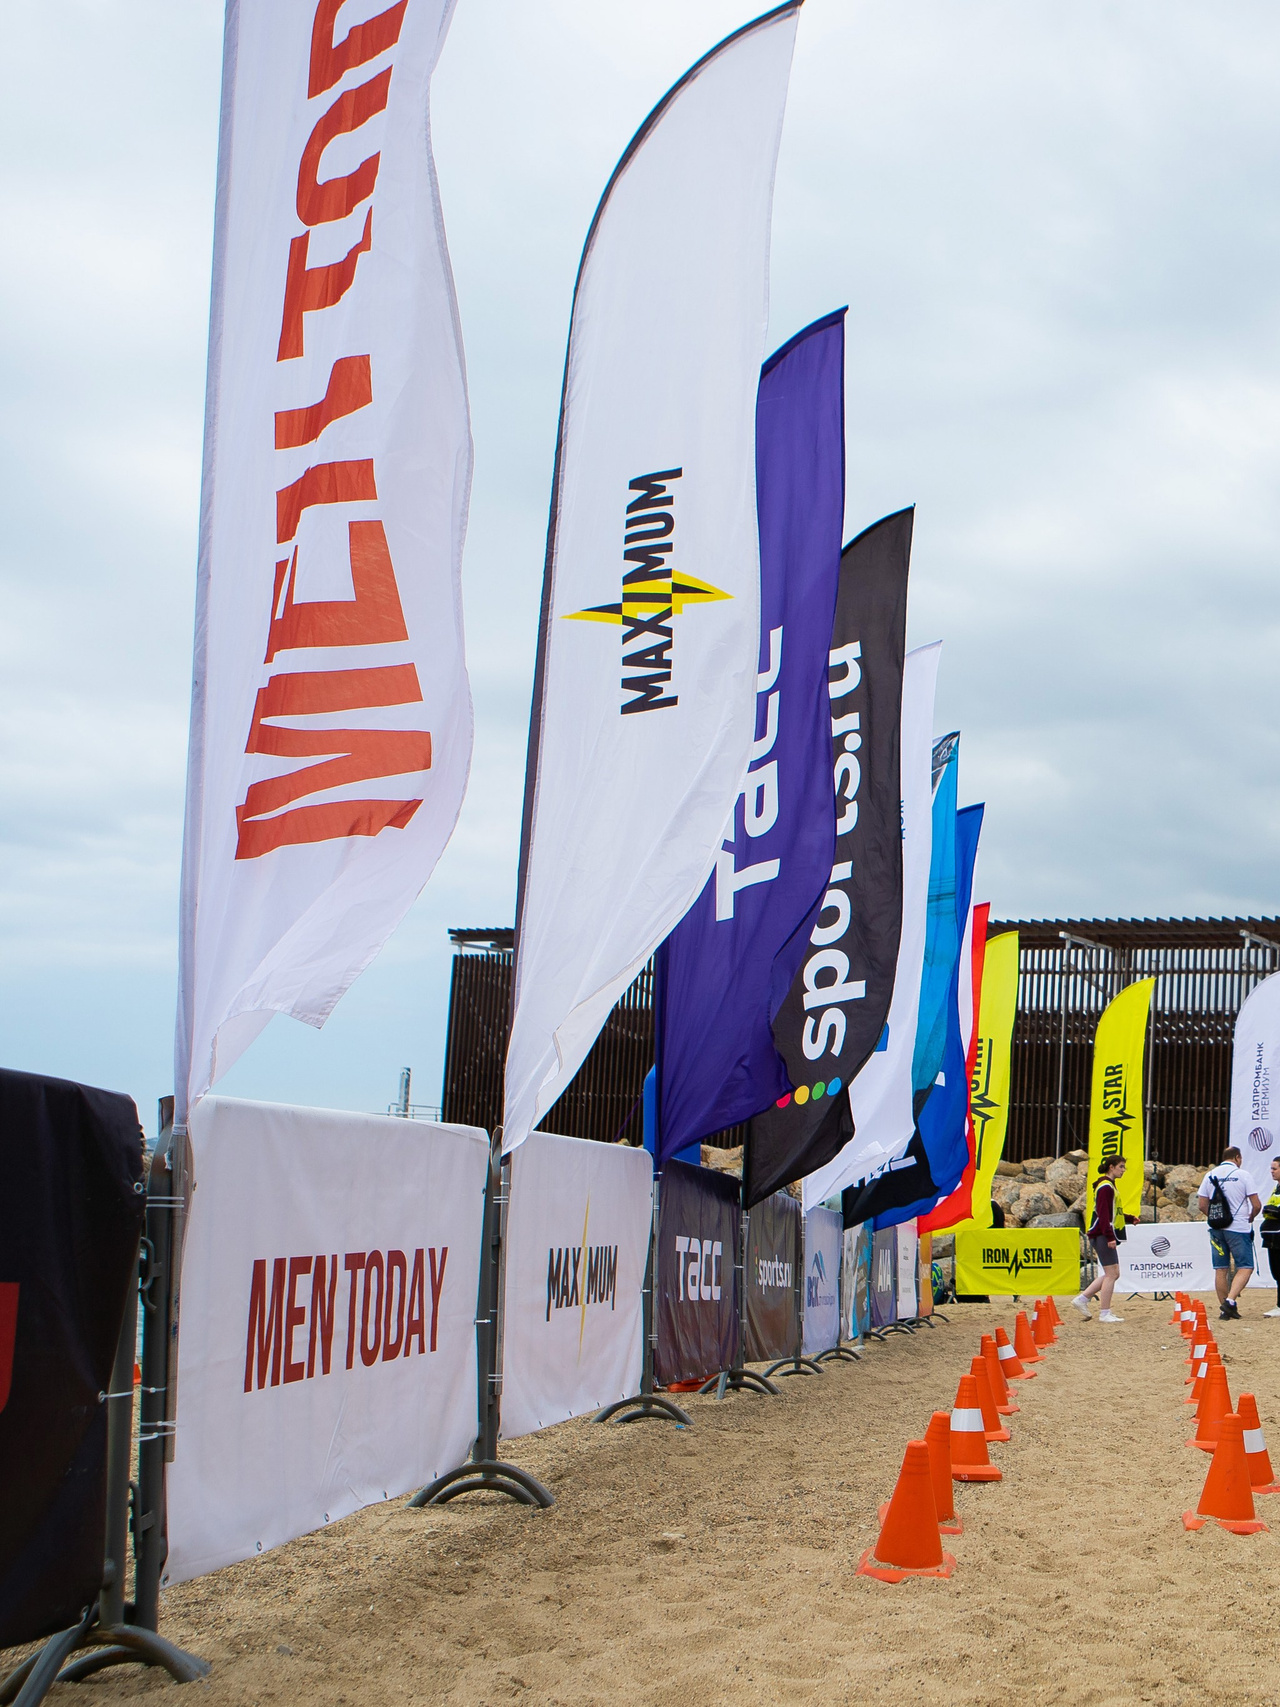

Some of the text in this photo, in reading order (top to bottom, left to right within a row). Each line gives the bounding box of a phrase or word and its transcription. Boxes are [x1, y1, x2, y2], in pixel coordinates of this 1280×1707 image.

[1102, 1063, 1123, 1110] STAR
[1252, 1041, 1264, 1121] ГАЗПРОМБАНК
[1261, 1067, 1270, 1120] ПРЕМИУМ
[758, 1253, 792, 1294] sports.ru
[982, 1248, 1052, 1263] IRON STAR
[1130, 1262, 1193, 1271] ГАЗПРОМБАНК
[1141, 1271, 1183, 1279] ПРЕМИУМ
[243, 1246, 449, 1393] MEN TODAY
